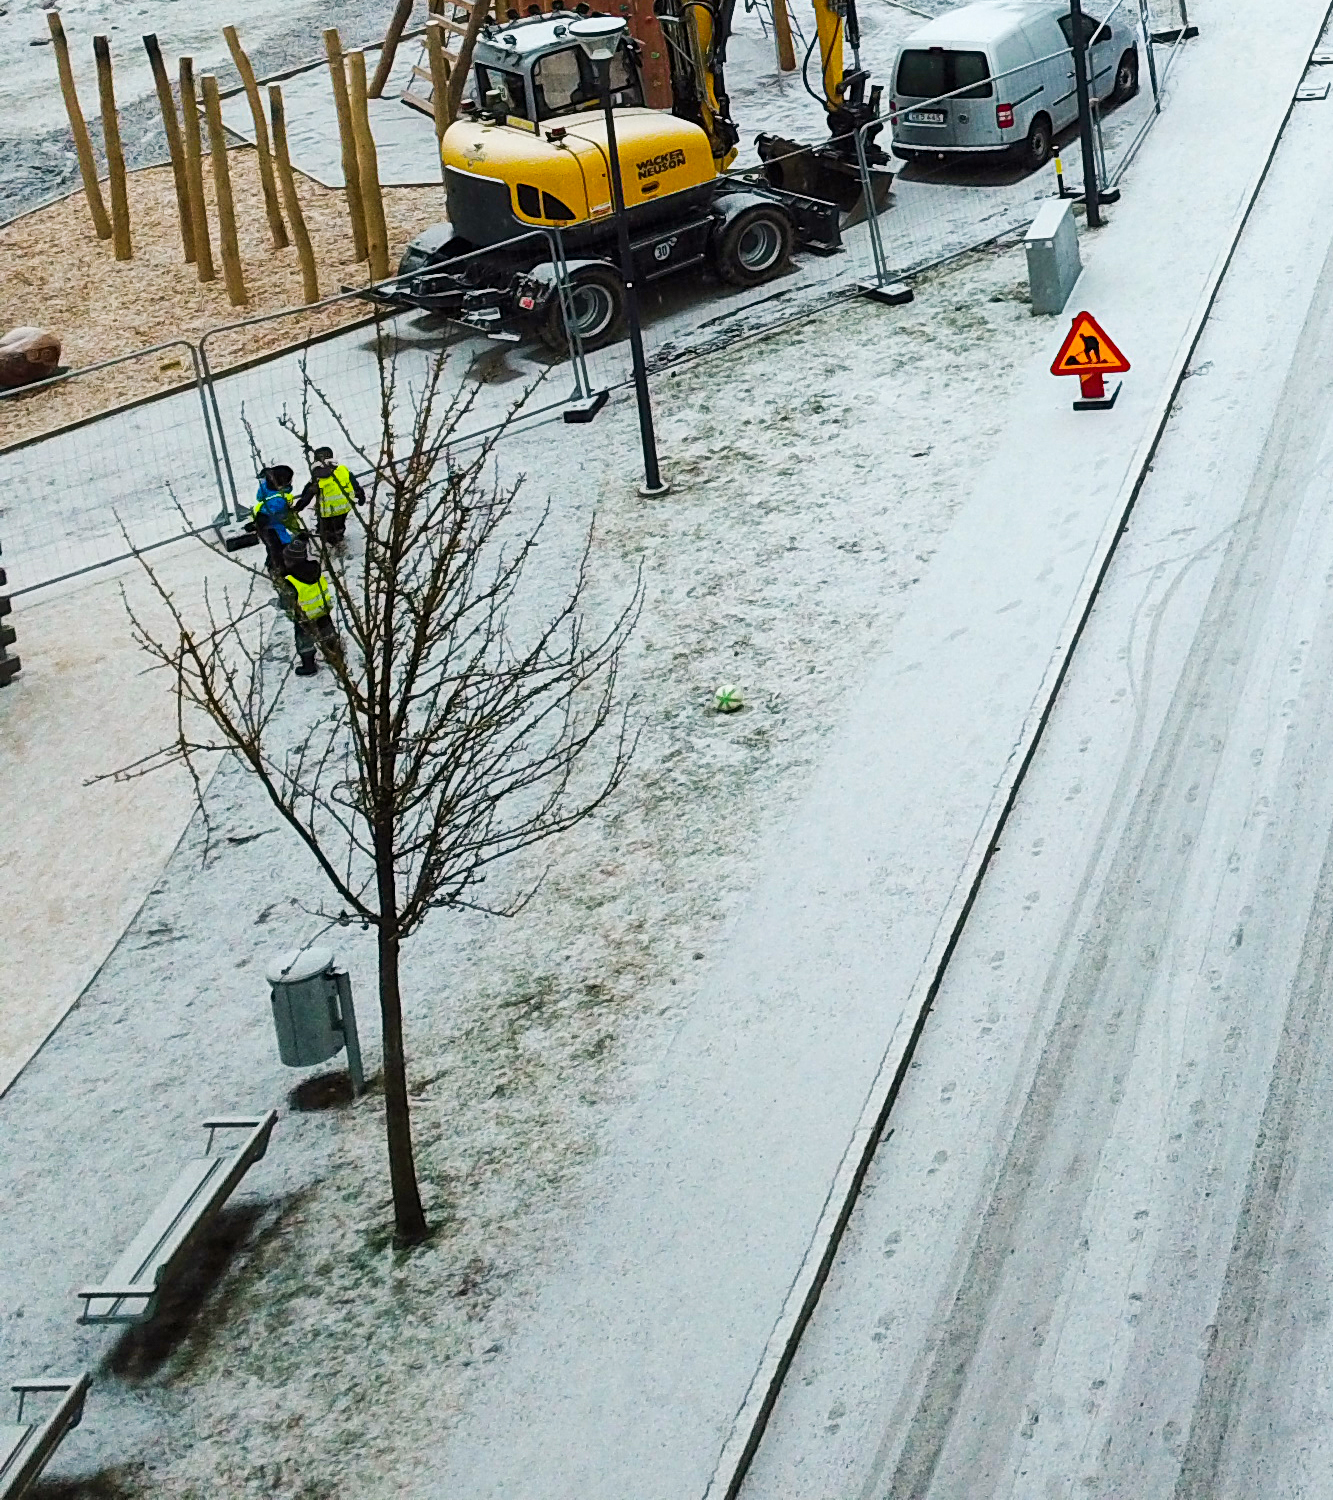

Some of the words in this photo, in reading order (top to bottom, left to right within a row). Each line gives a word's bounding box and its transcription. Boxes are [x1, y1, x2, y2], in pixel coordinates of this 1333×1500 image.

[636, 149, 685, 170] WACKER
[638, 158, 686, 180] NEUSON
[656, 244, 668, 259] 30
